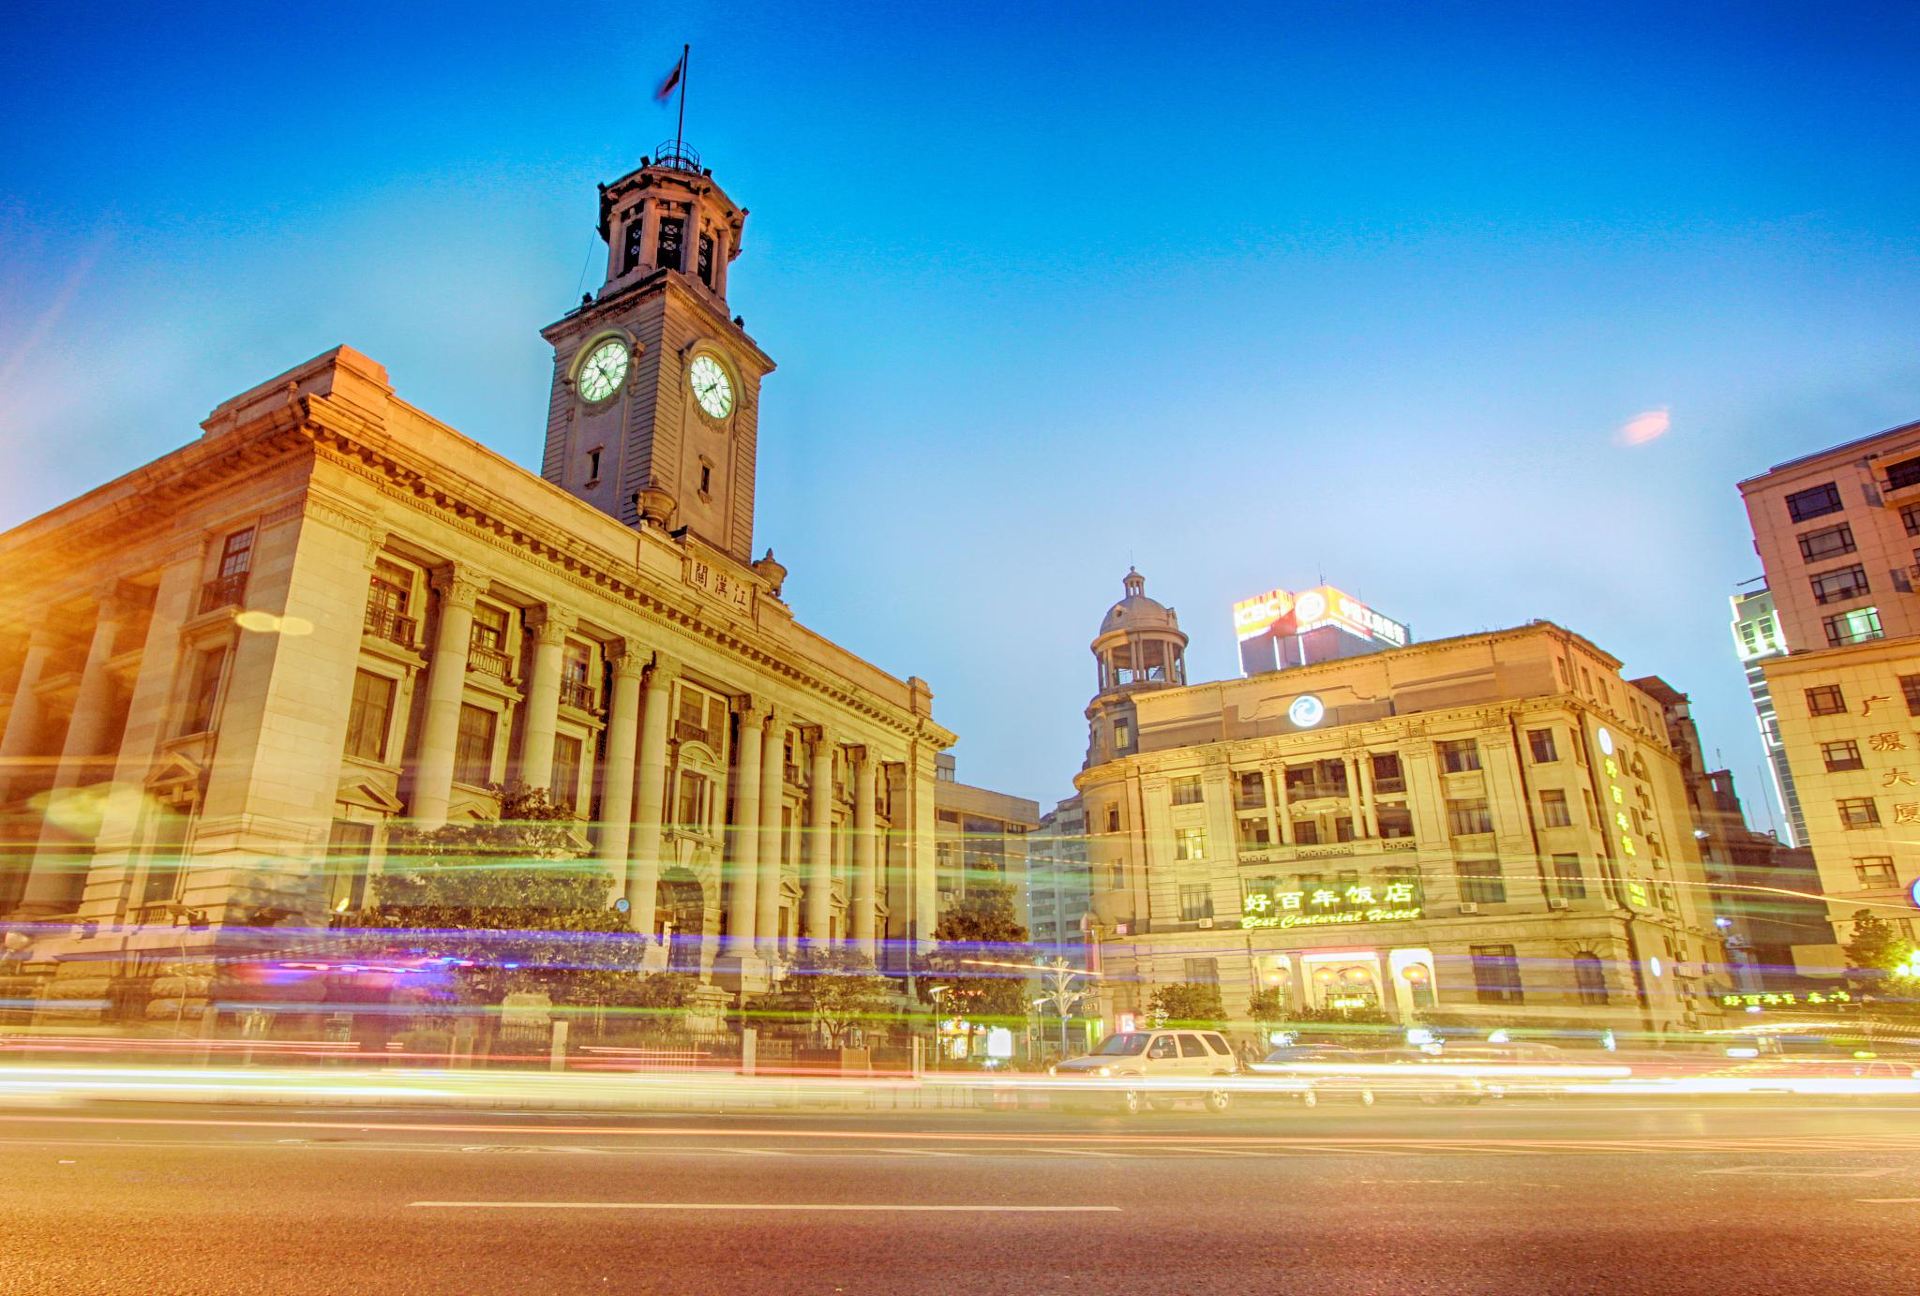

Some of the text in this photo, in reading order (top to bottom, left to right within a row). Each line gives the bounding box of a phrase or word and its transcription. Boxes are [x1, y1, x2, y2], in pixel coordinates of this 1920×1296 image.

[1862, 695, 1920, 824] 广源大厦
[1243, 883, 1414, 912] 好百年饭店
[1240, 915, 1278, 929] Best
[1365, 907, 1421, 921] Hotel
